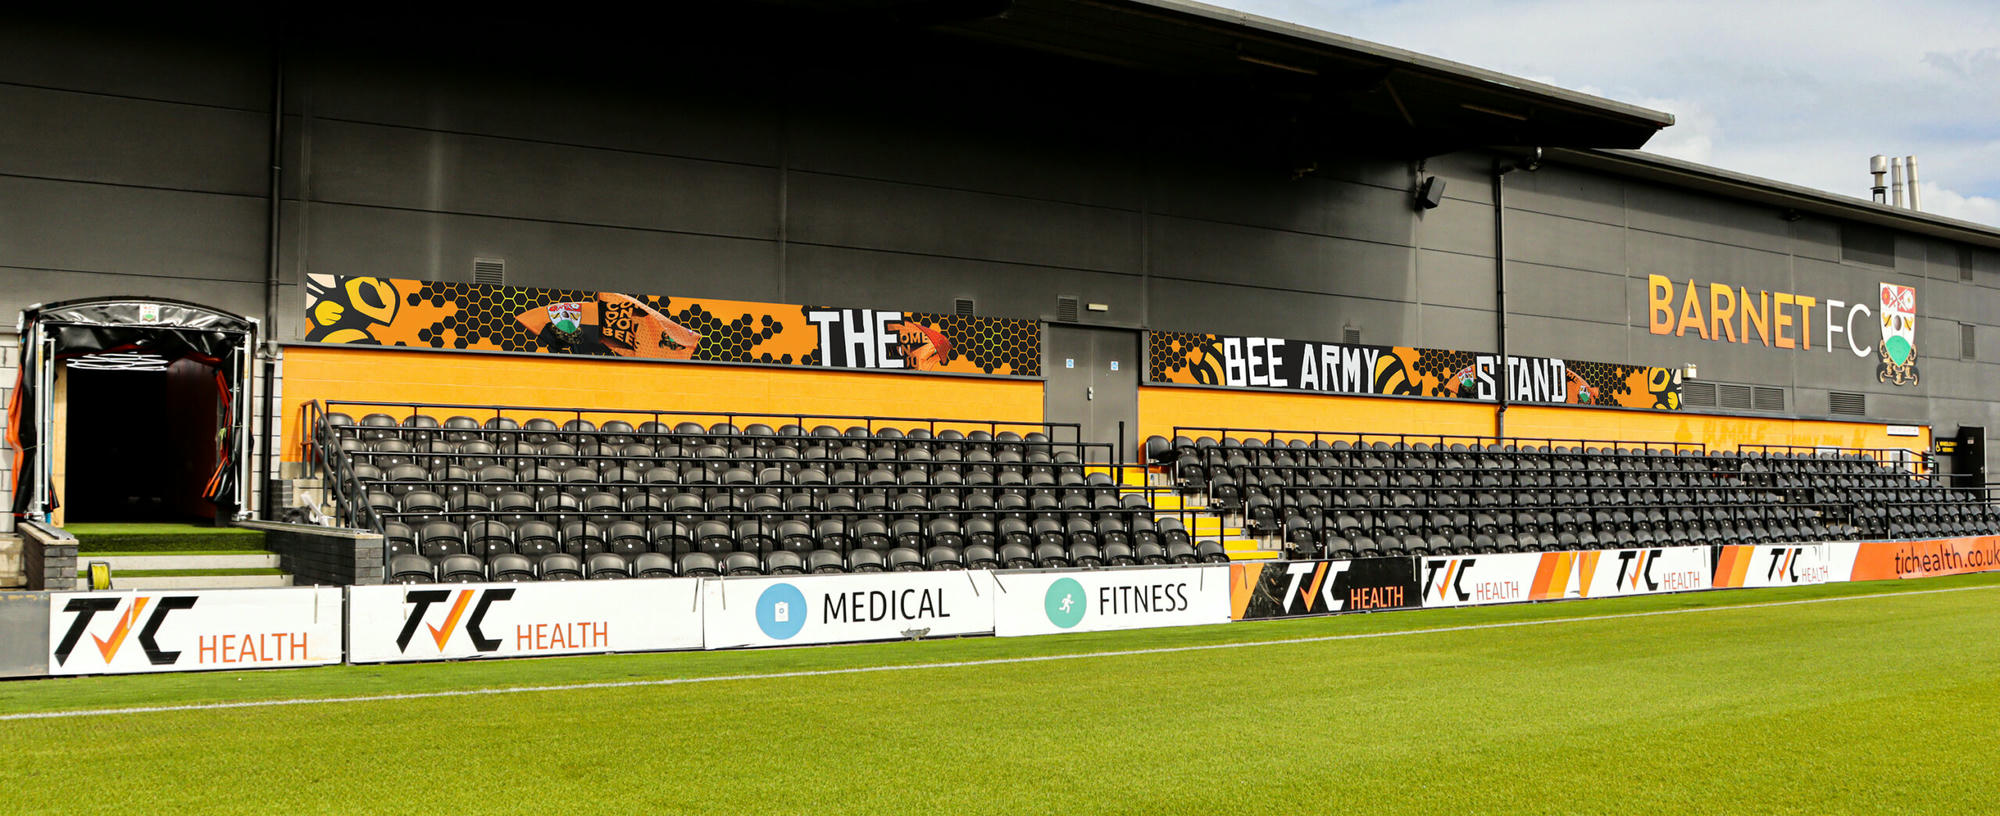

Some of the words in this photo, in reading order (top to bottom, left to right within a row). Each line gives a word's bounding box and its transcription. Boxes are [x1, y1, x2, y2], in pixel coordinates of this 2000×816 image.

[1649, 274, 1817, 350] BARNET
[1826, 299, 1872, 358] FC
[809, 309, 904, 368] THE
[1224, 337, 1288, 387] BEE
[1300, 344, 1379, 394] ARMY
[1476, 356, 1566, 403] STAND
[1801, 565, 1829, 584] HEALTH
[1895, 540, 2000, 575] tichealth.co.uk
[1351, 586, 1404, 610] HEALTH
[1476, 581, 1519, 601] HEALTH
[1663, 571, 1701, 591] HEALTH
[823, 587, 951, 625] MEDICAL
[1099, 582, 1188, 616] FITNESS
[199, 632, 308, 664] HEALTH
[516, 621, 609, 651] HEALTH
